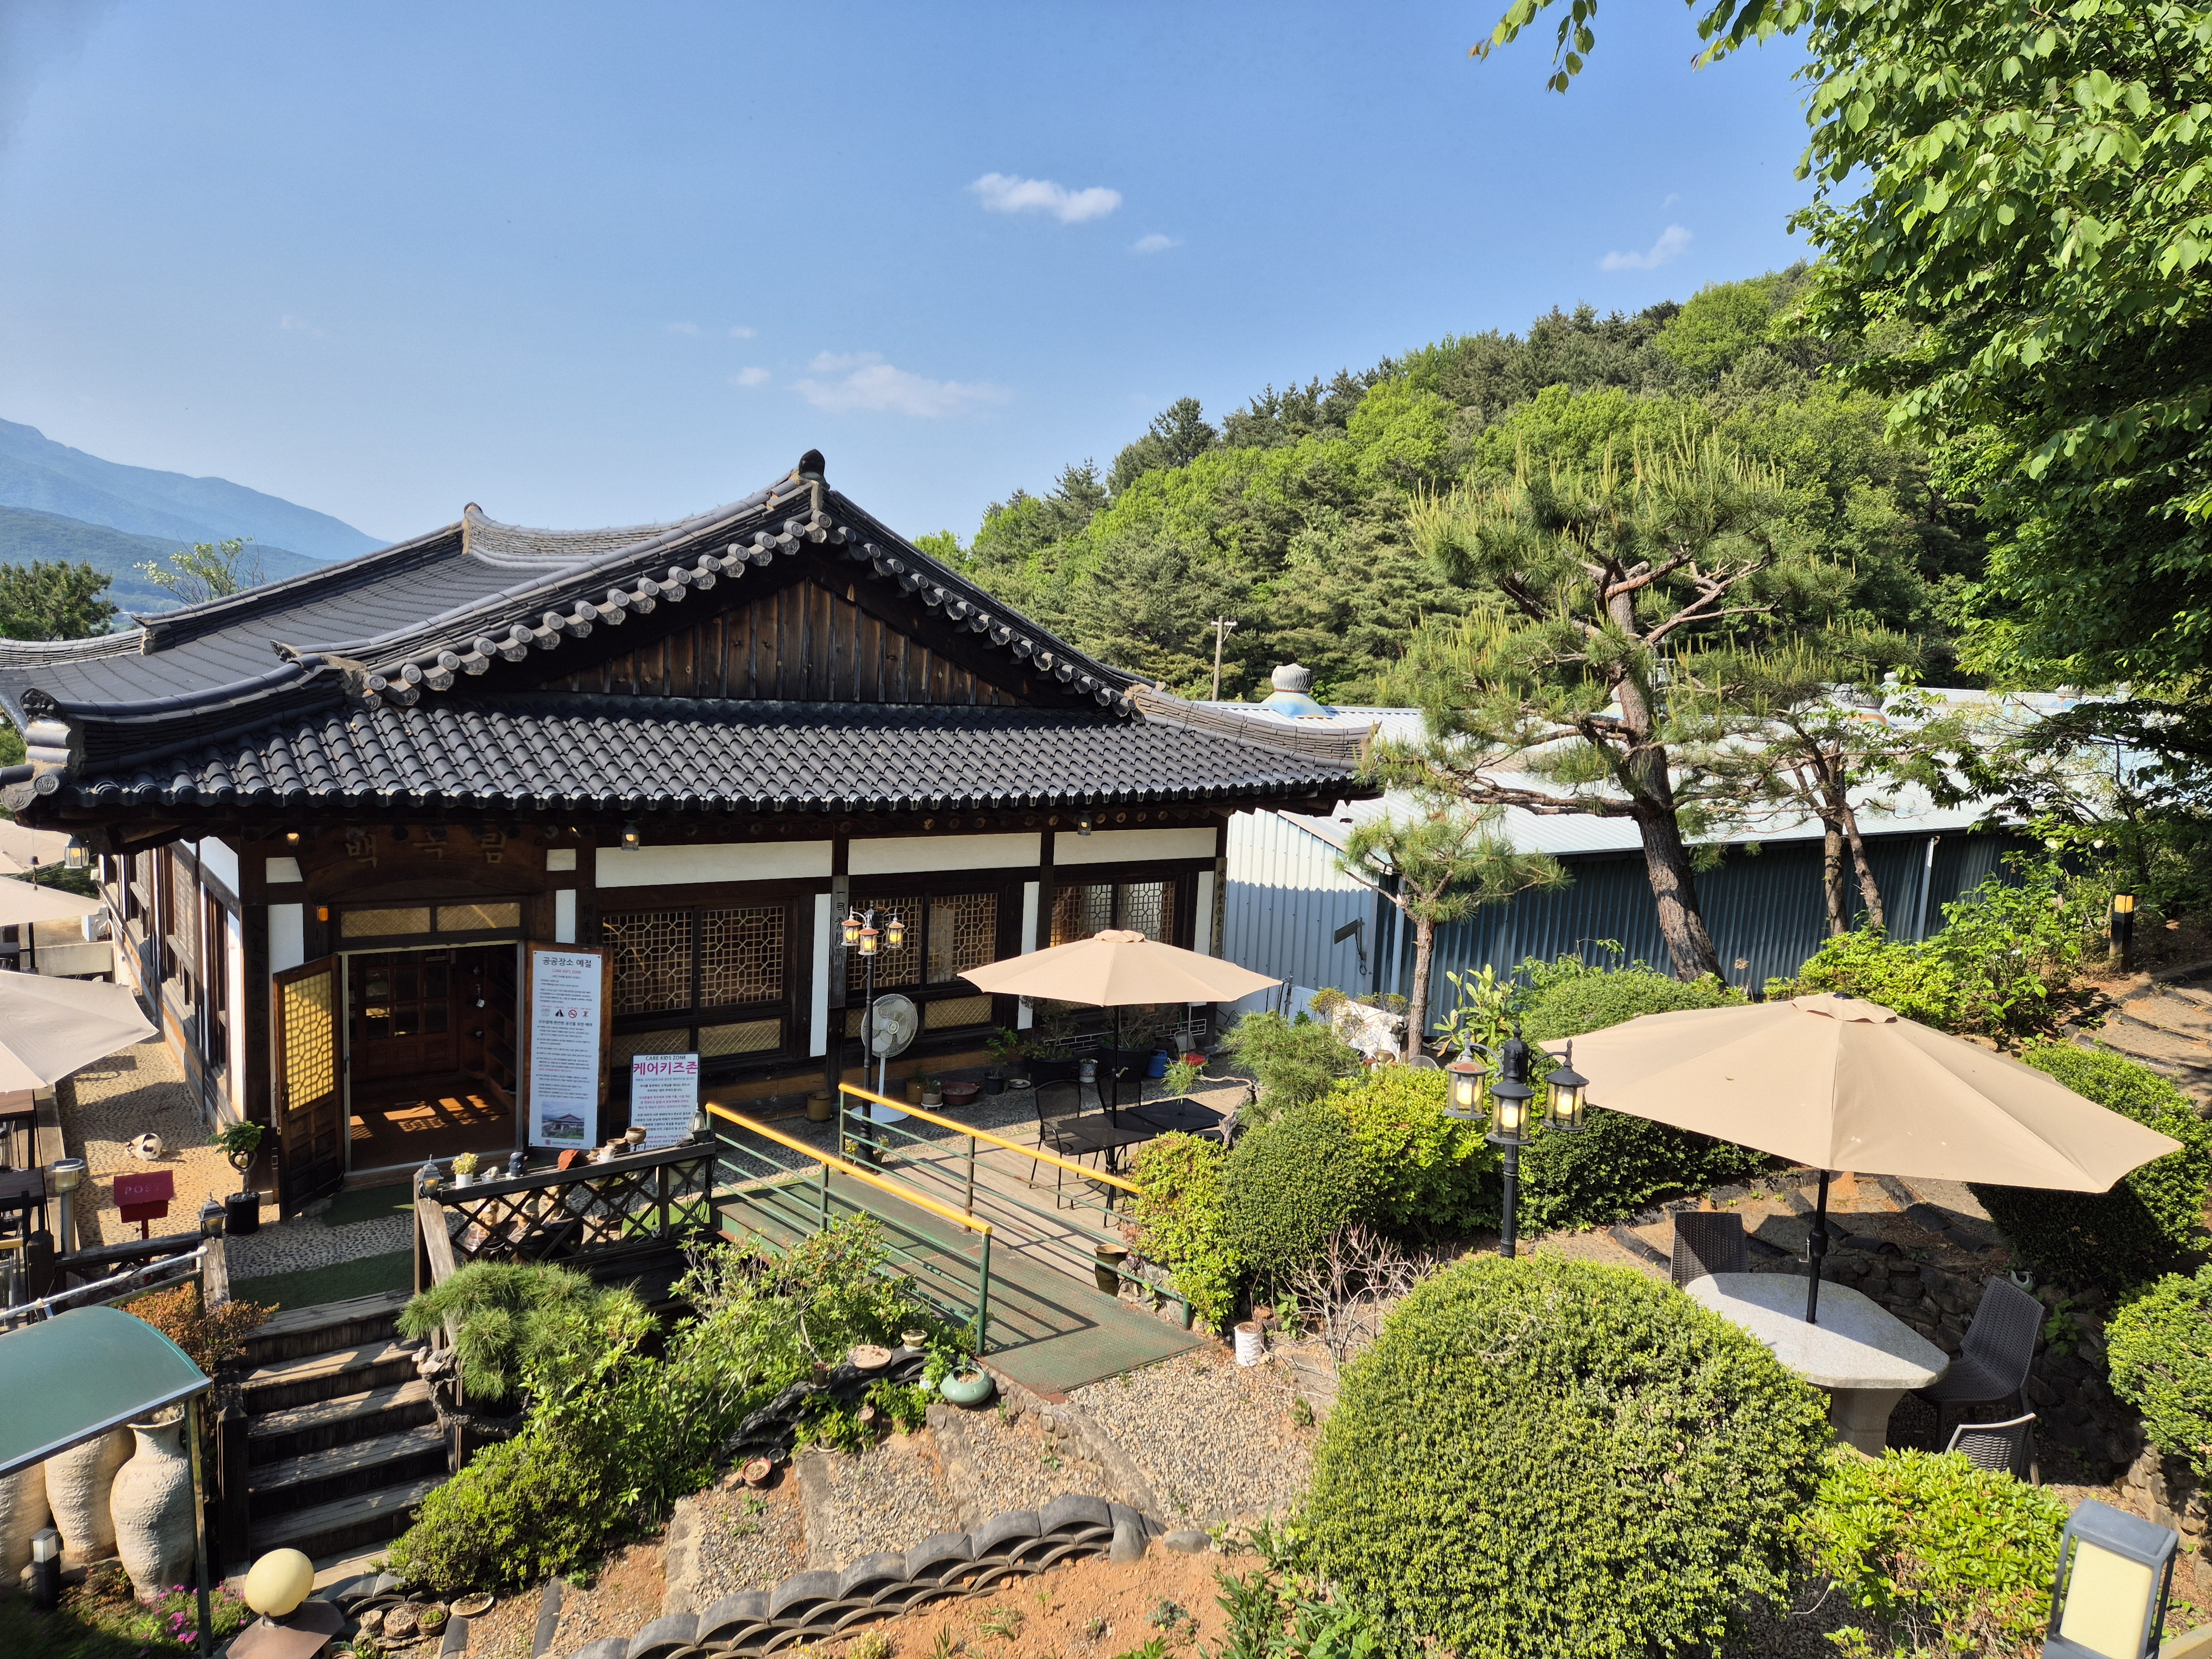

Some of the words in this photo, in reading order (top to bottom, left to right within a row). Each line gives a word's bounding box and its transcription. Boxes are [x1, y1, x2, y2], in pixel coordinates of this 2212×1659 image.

[542, 957, 573, 966] 공공장소
[576, 959, 592, 968] 예절
[633, 1061, 698, 1076] 케어키즈존
[124, 1184, 159, 1195] POS
